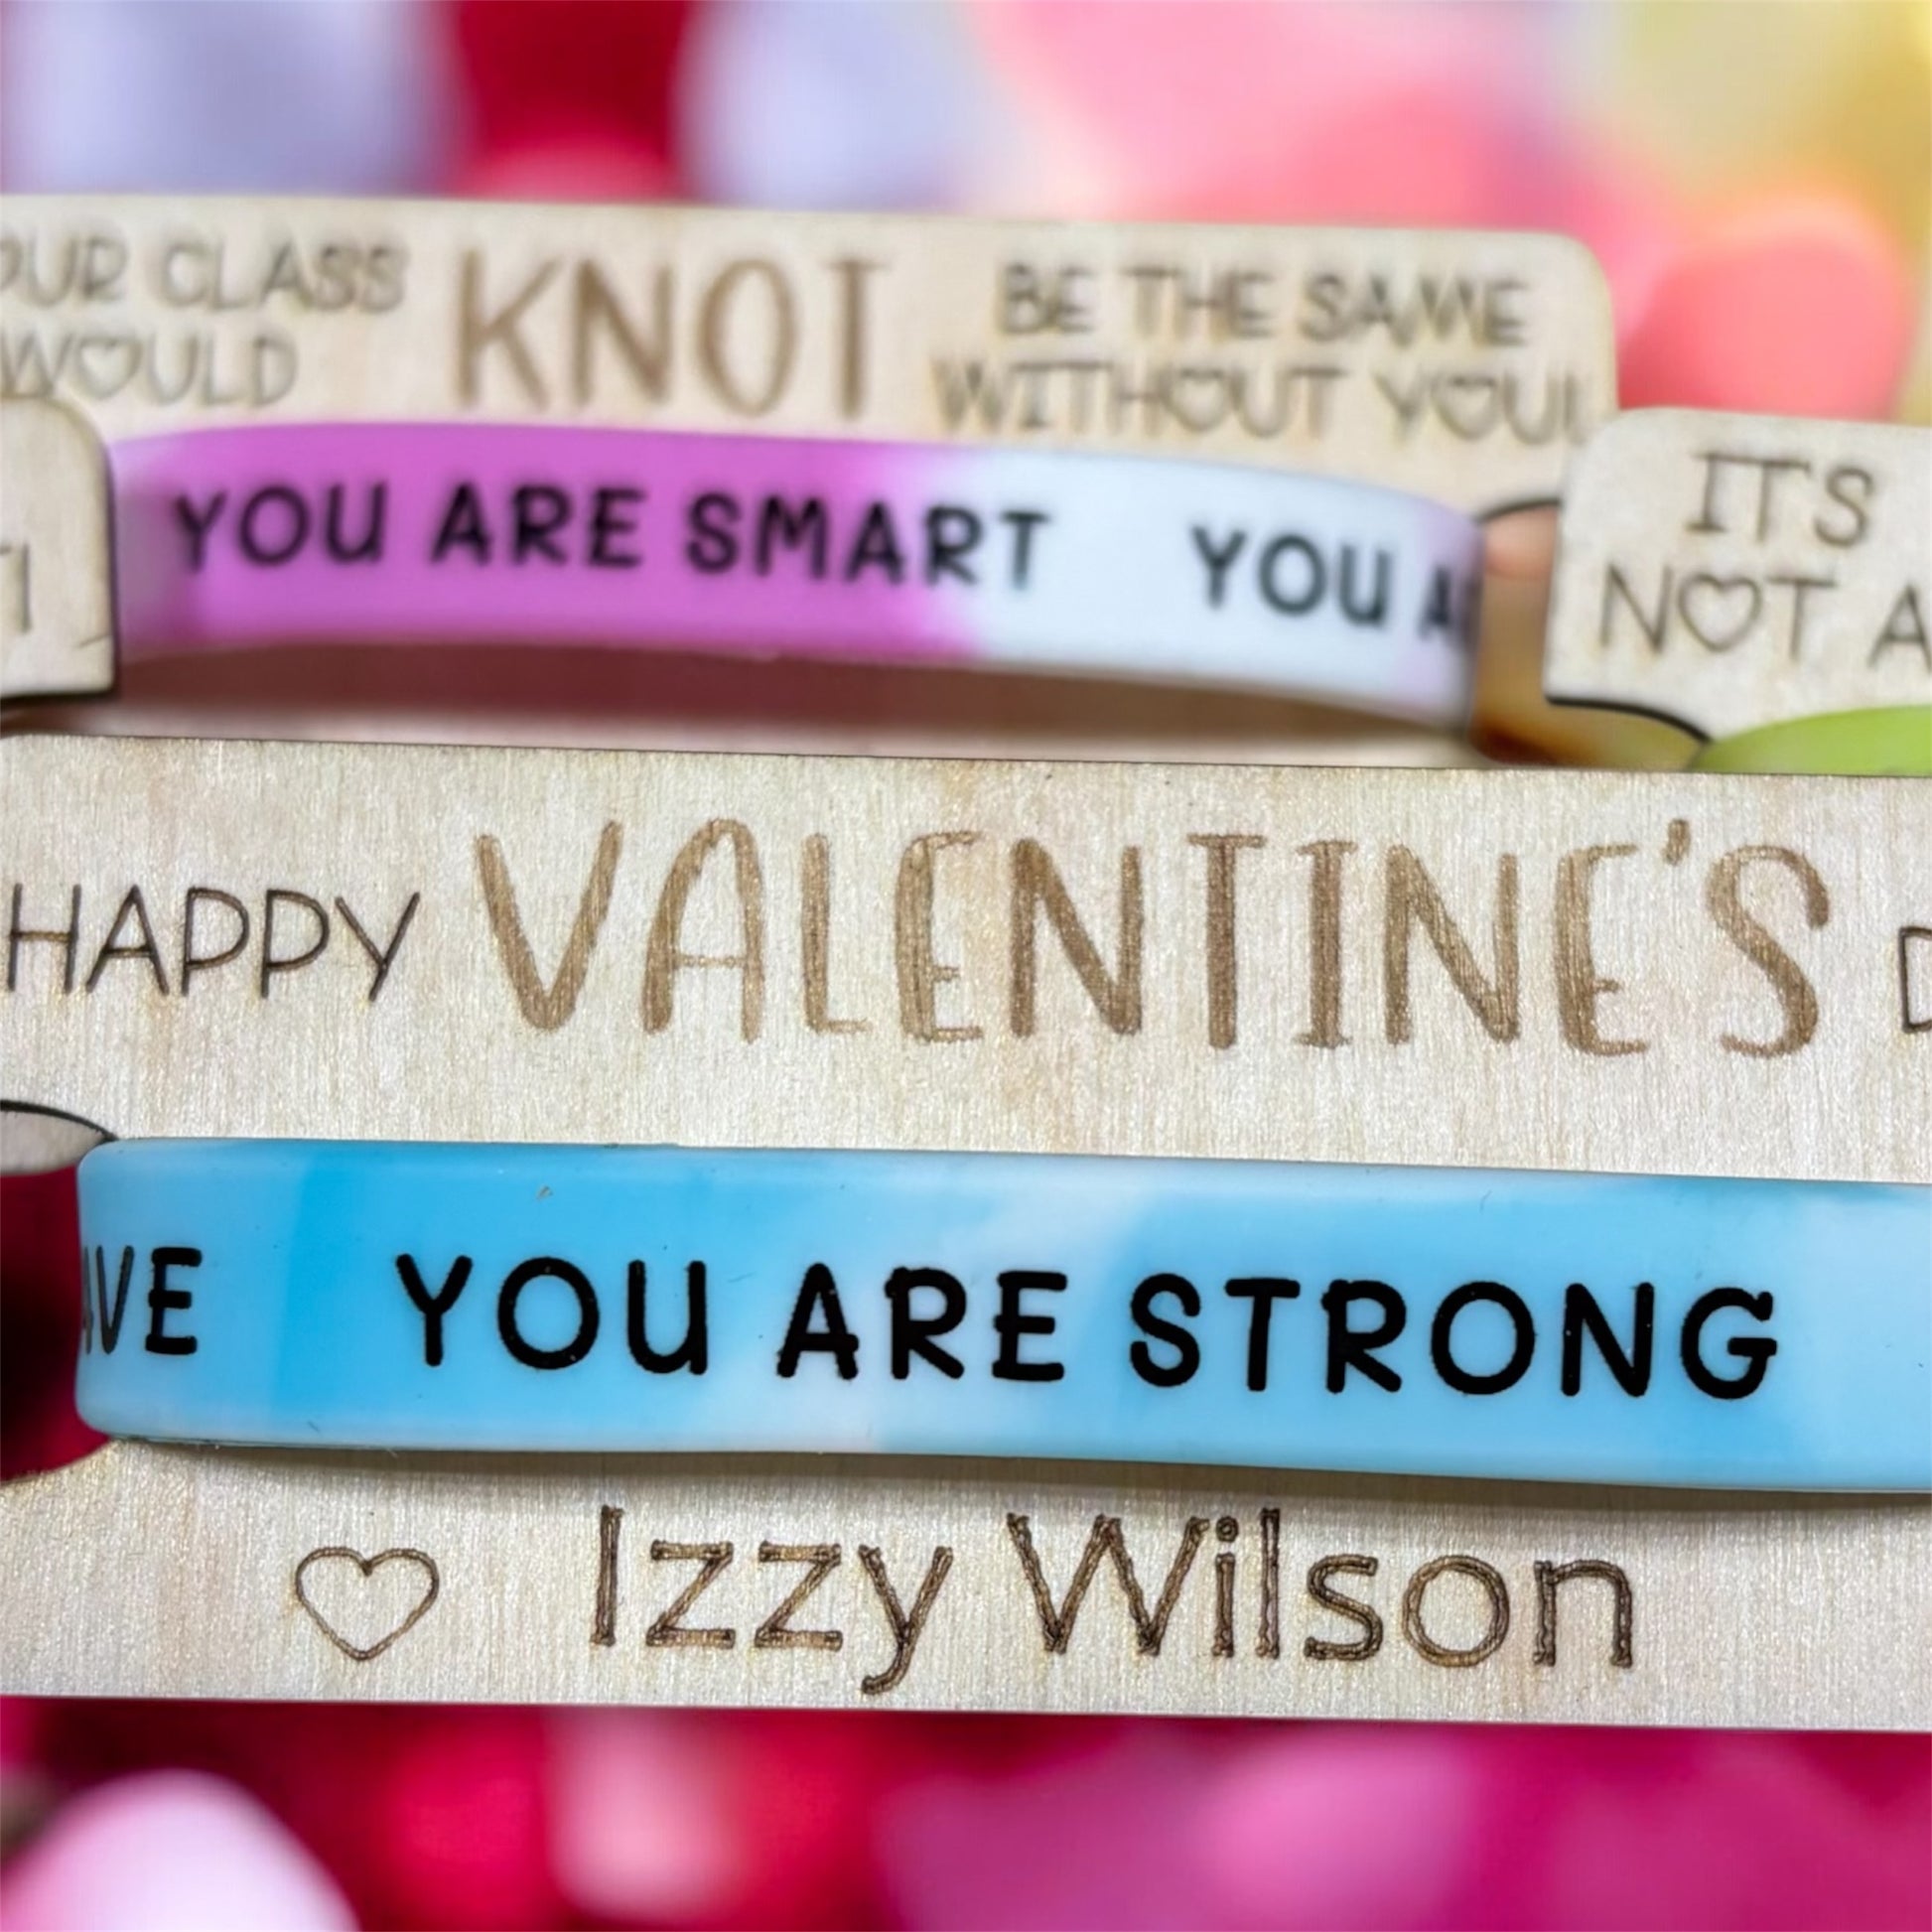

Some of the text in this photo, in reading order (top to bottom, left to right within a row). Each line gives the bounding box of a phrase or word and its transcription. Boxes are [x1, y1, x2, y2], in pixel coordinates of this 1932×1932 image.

[161, 238, 408, 313] CLASS
[999, 261, 1530, 348] BE THE SAME
[0, 332, 298, 408] WOULD
[458, 248, 892, 419] KNOT
[927, 355, 1347, 439] WITHOUT
[173, 481, 1052, 591] YOU ARE SMART
[1190, 524, 1394, 628] YOU
[1599, 563, 1838, 663] NOT
[8, 883, 421, 1002] HAPPY
[475, 819, 1830, 1058] VALENTINE'S
[395, 1254, 1778, 1400] YOU ARE STRONG
[590, 1505, 1634, 1695] Izzy Wilson
